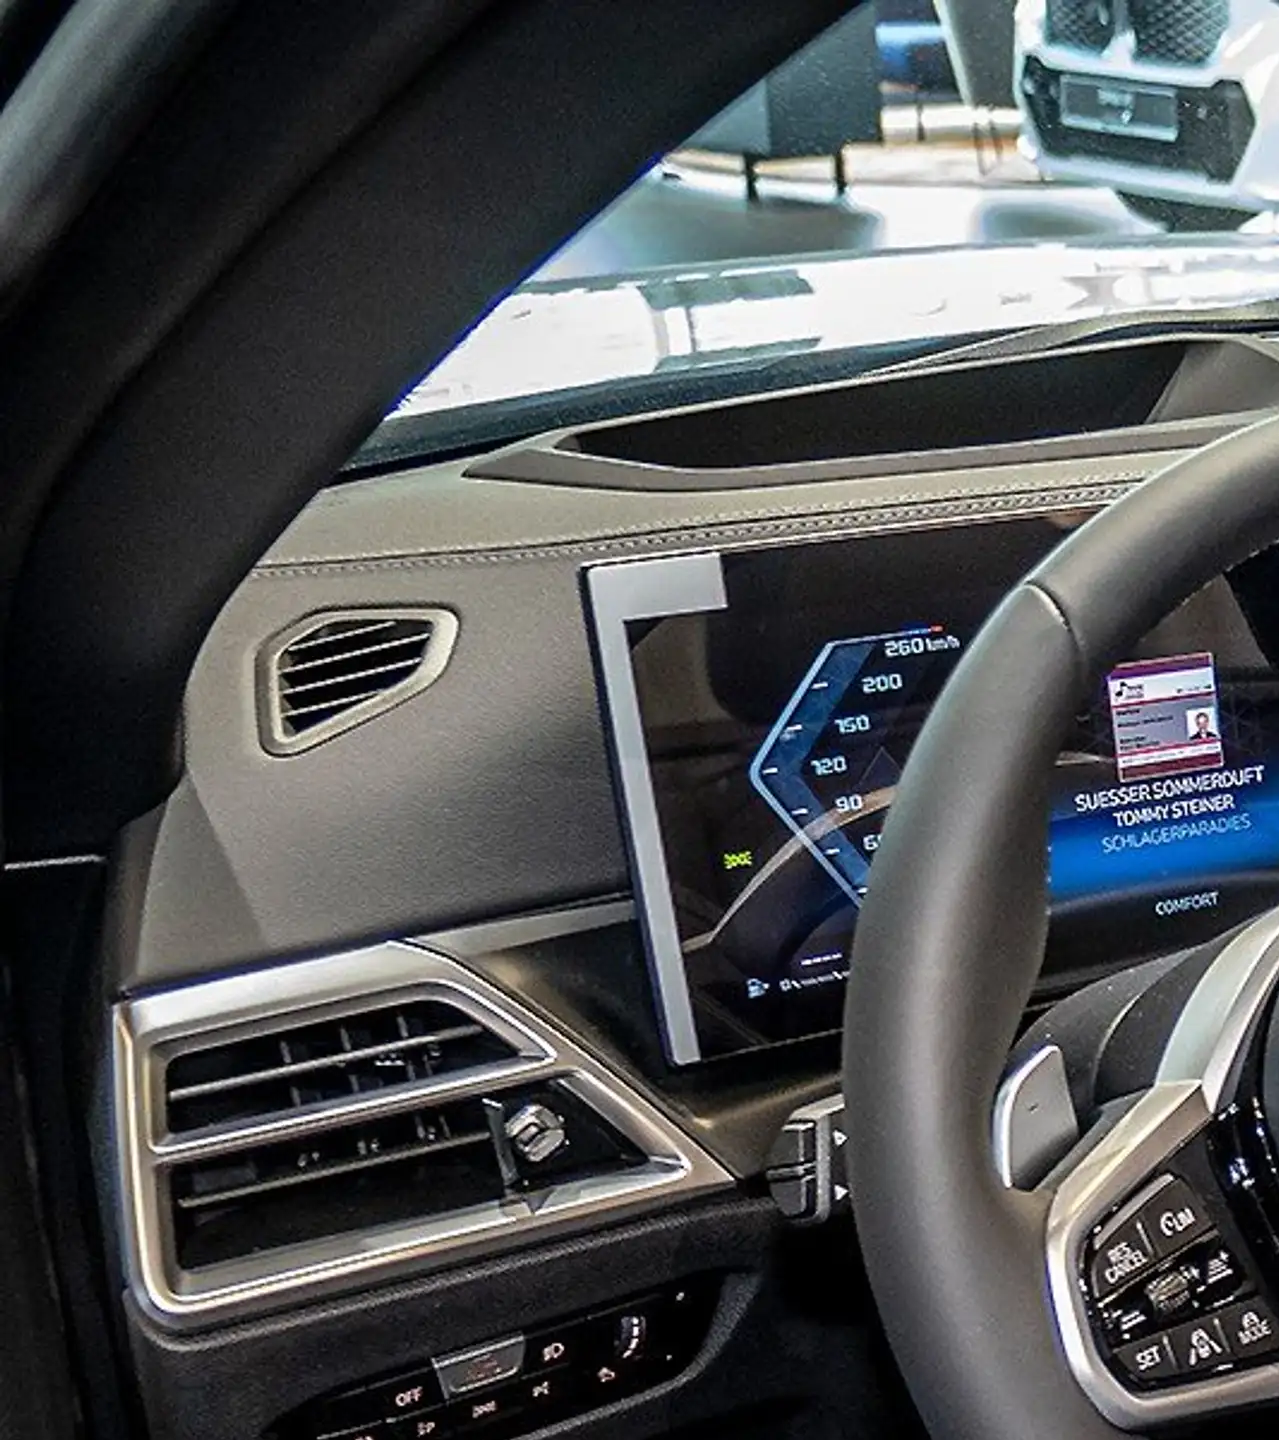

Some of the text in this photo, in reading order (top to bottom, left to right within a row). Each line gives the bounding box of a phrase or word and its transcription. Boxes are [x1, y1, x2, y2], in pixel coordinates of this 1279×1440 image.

[885, 637, 924, 657] 260
[861, 673, 903, 694] 200
[834, 714, 871, 734] 150
[811, 756, 848, 775] 120
[1074, 765, 1265, 812] SUESSER SOMMERDUFT
[836, 794, 863, 813] 90
[1112, 793, 1236, 828] TOMMY STEINER
[1101, 812, 1251, 854] SCHLAGERPARADIES
[1154, 891, 1220, 916] COMFORT
[1104, 1249, 1148, 1285] CANCEL
[1135, 1345, 1161, 1371] SET
[395, 1386, 423, 1407] OFF
